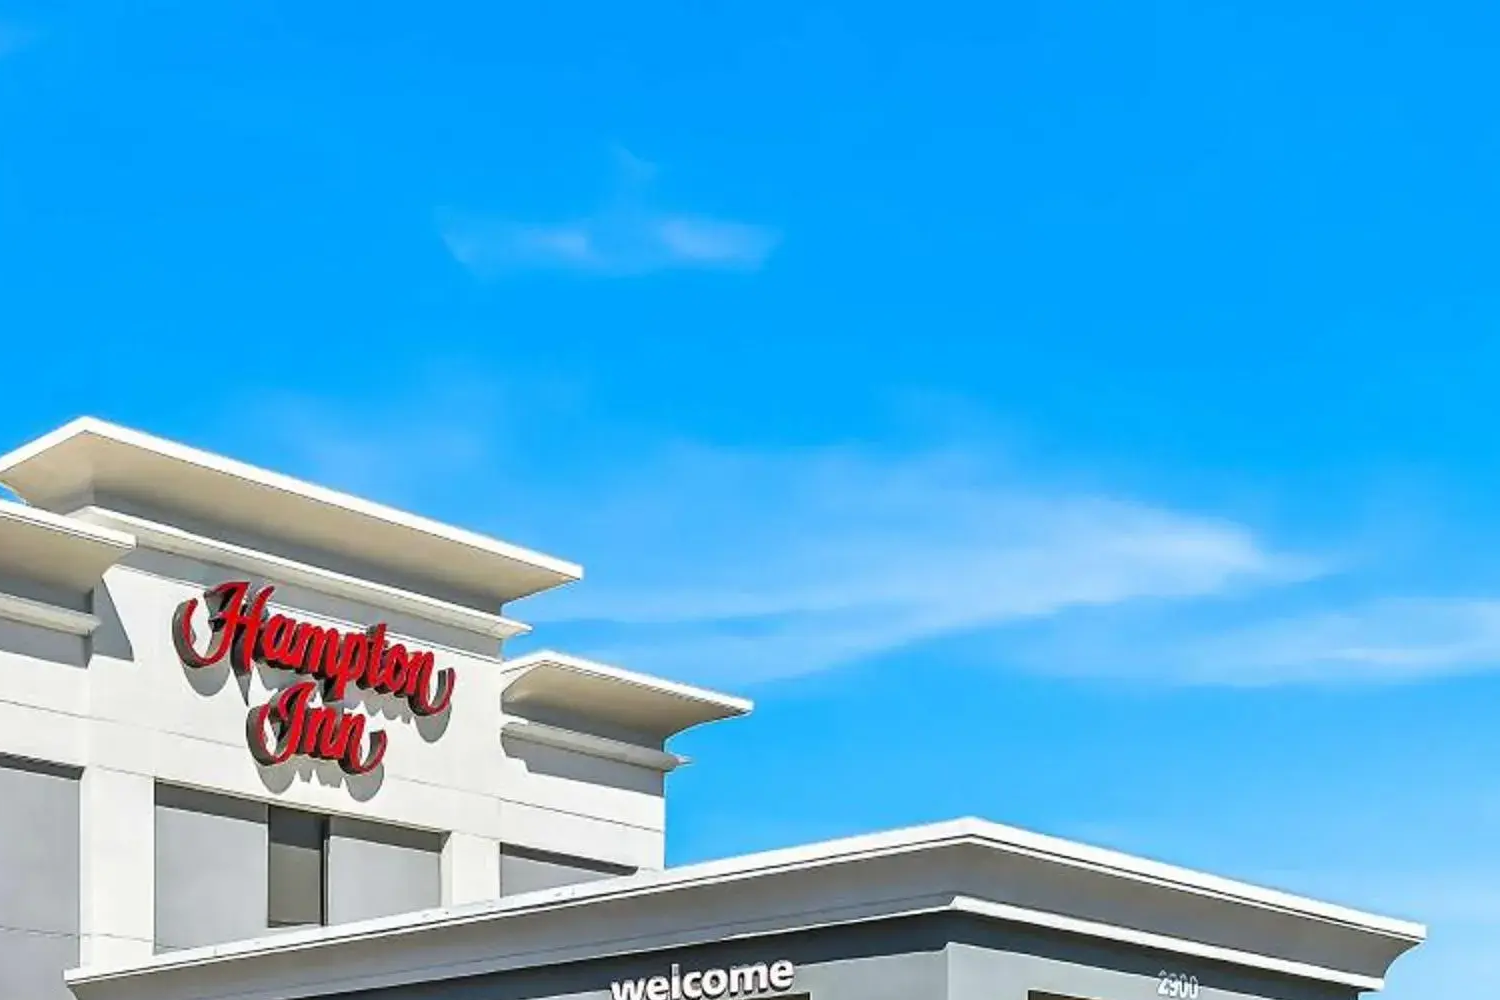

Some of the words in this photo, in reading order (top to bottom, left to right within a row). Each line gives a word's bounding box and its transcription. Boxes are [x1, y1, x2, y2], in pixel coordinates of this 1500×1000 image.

[175, 581, 456, 716] Hampton
[249, 682, 388, 774] Inn
[1157, 970, 1199, 999] 2900
